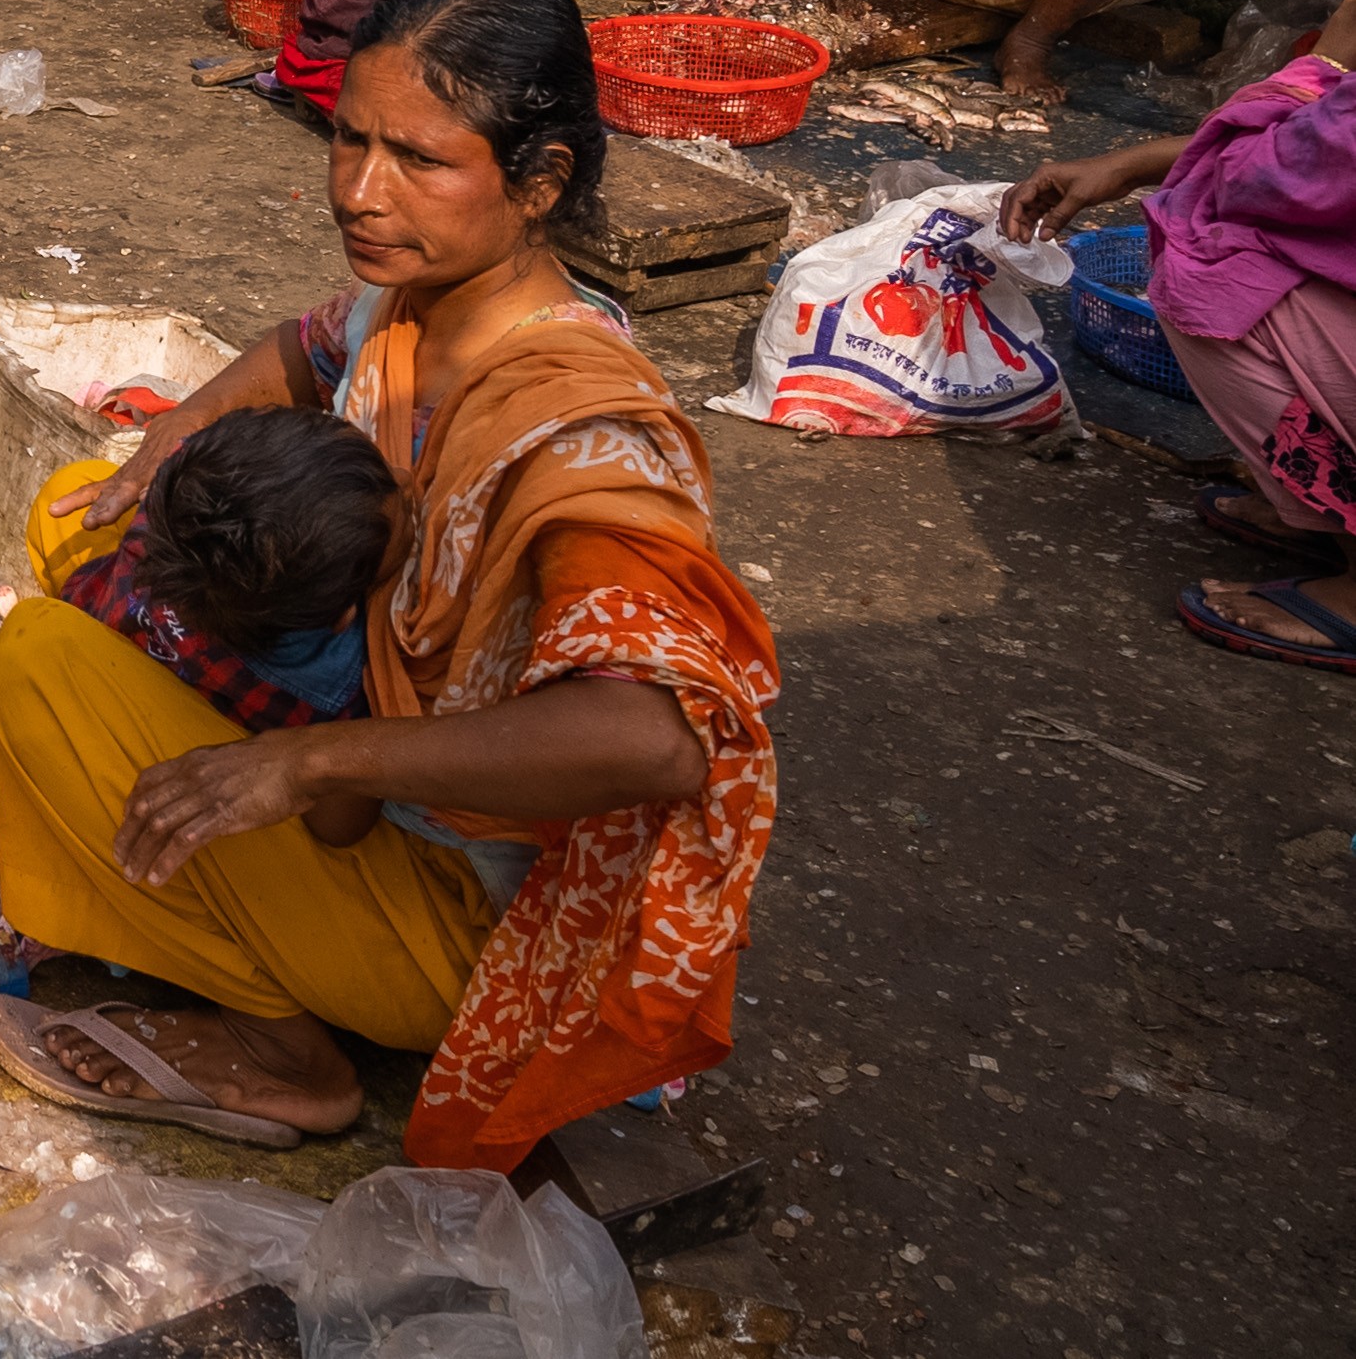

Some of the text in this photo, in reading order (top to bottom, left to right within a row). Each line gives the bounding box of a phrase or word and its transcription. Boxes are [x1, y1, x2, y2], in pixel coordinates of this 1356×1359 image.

[845, 332, 873, 352] মনের
[873, 341, 895, 362] সুখে
[895, 352, 921, 377] বাজার
[993, 372, 1015, 392] গড়ি
